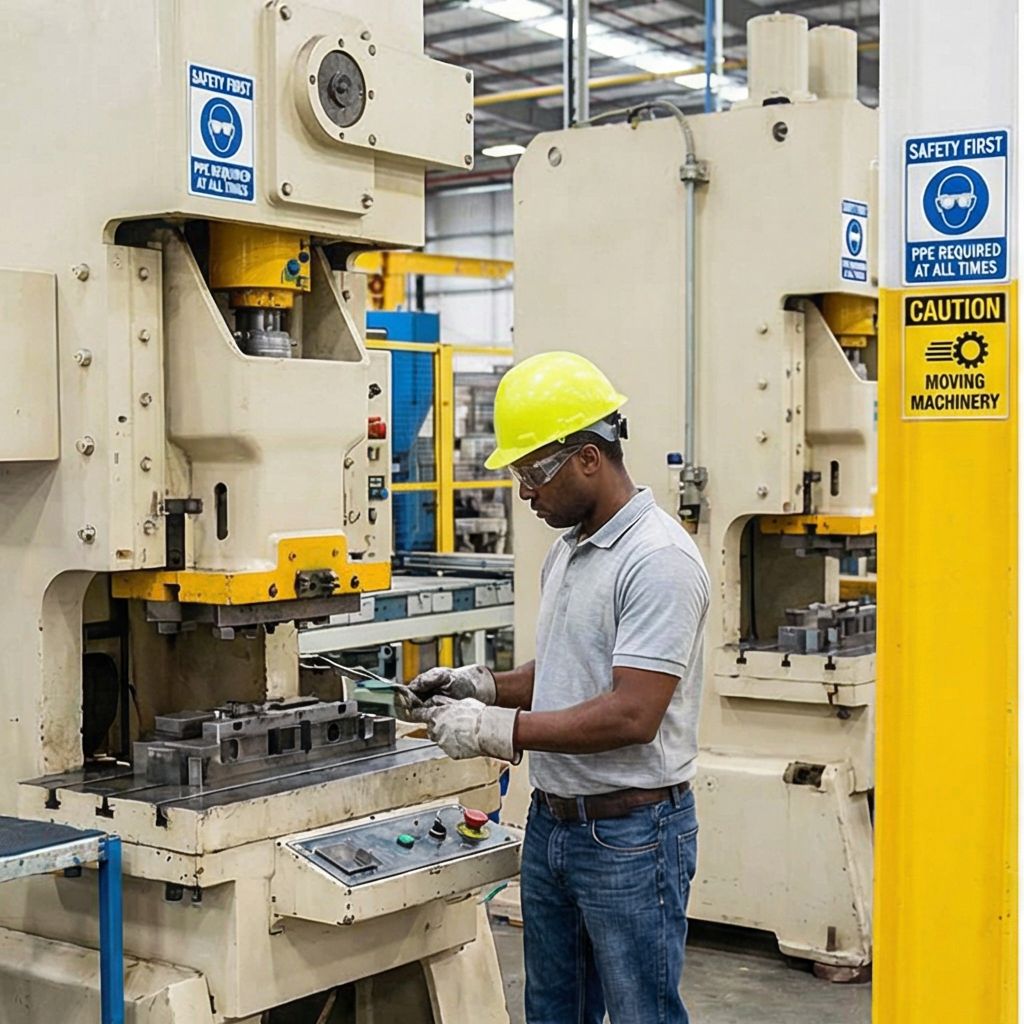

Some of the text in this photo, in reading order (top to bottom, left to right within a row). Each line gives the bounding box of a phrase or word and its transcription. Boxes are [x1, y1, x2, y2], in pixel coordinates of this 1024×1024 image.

[909, 136, 1004, 160] SAFETY FIRST
[911, 242, 1001, 262] PPE REQUIRED
[914, 260, 998, 278] AT ALL TIMES
[909, 297, 1001, 322] CAUTION
[925, 373, 985, 390] MOVING
[911, 393, 1000, 411] MACHINERY
